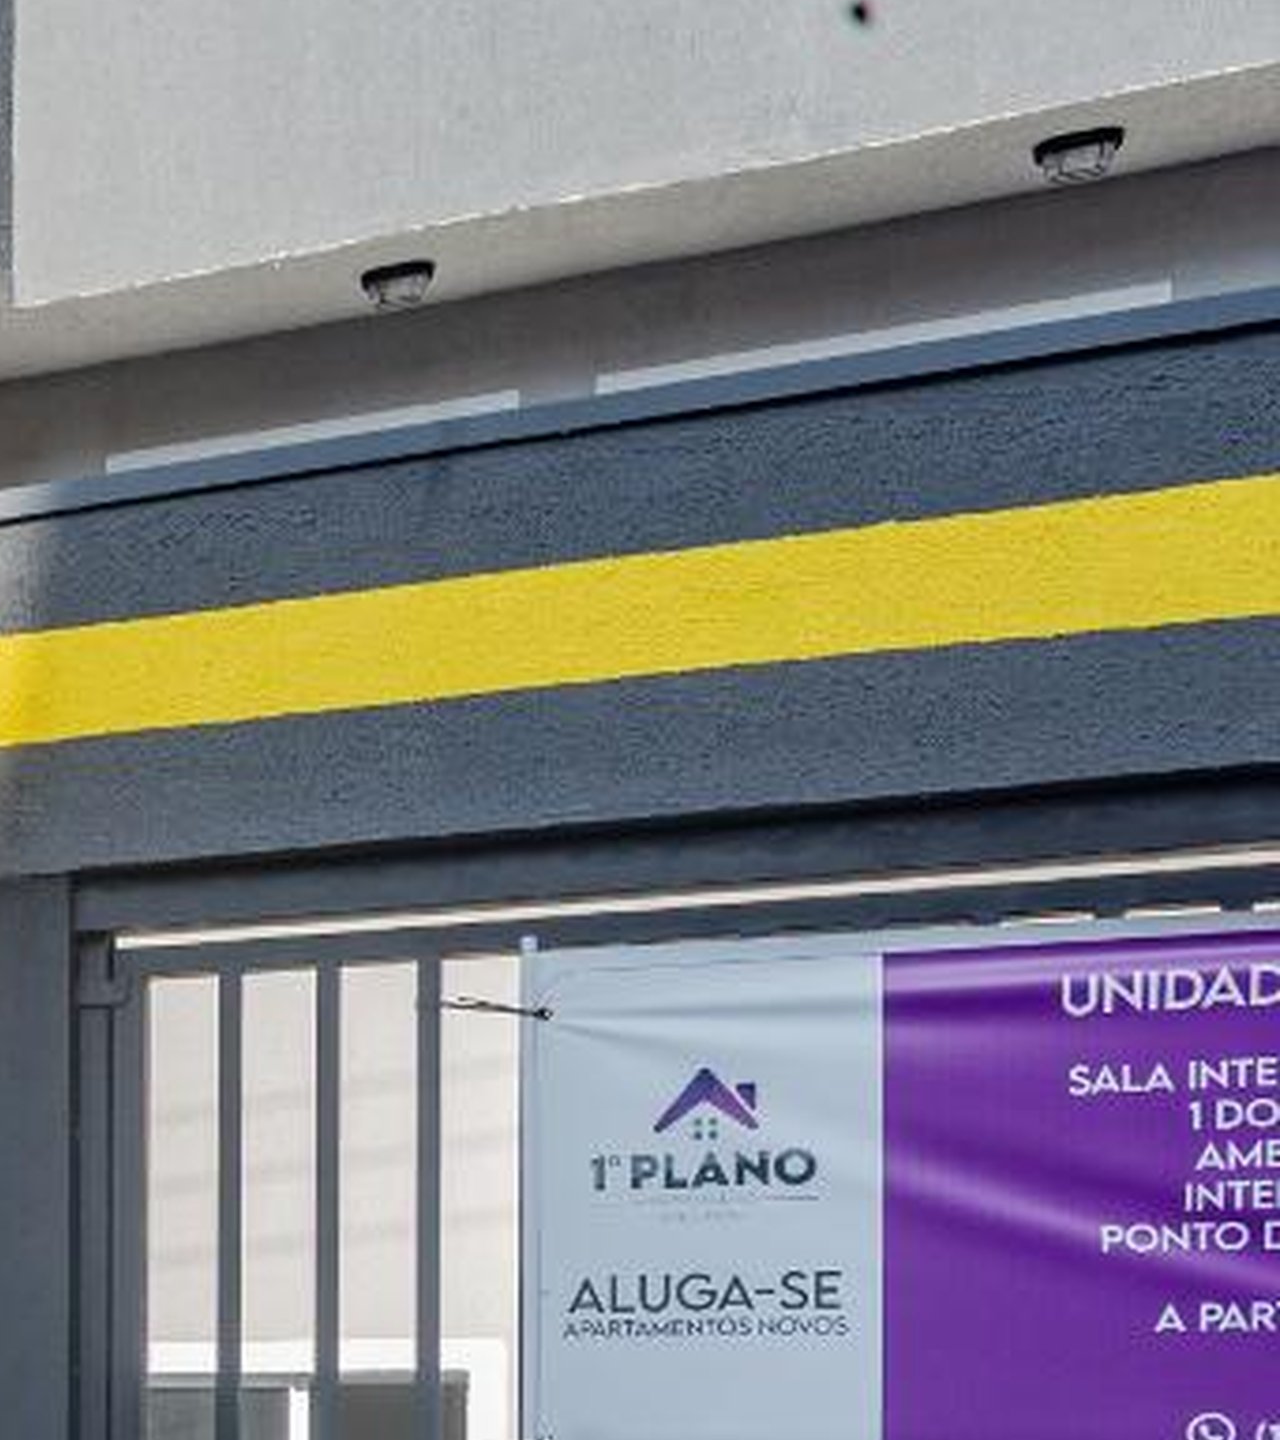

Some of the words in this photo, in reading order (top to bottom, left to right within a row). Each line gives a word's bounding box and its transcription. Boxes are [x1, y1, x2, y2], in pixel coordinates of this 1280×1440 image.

[1061, 964, 1280, 1017] UNIDAD
[1068, 1062, 1176, 1097] SALA
[1188, 1057, 1278, 1091] INTE
[1189, 1101, 1204, 1131] 1
[629, 1148, 818, 1190] PLANO
[1184, 1180, 1280, 1212] INTE
[1099, 1221, 1250, 1254] PONTO
[569, 1270, 843, 1314] ALUGA-SE
[563, 1318, 753, 1339] APARTAMENTOS
[757, 1315, 850, 1337] NOVOS
[1154, 1303, 1186, 1333] A
[1199, 1300, 1280, 1332] PAR
